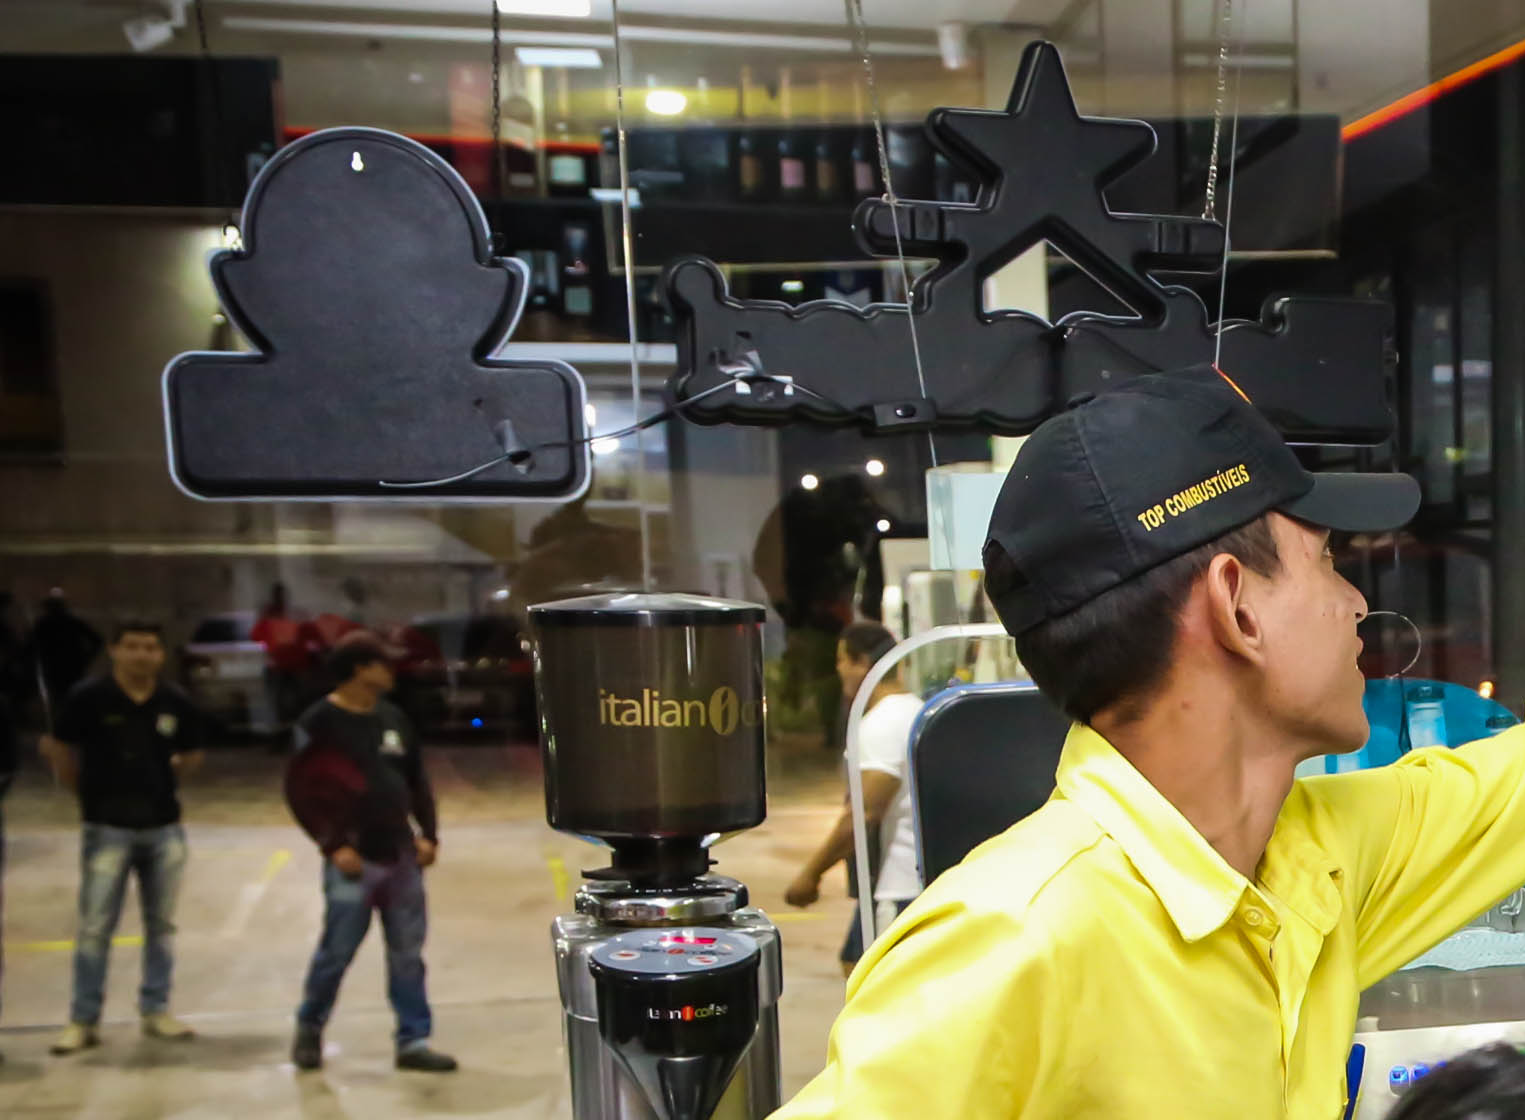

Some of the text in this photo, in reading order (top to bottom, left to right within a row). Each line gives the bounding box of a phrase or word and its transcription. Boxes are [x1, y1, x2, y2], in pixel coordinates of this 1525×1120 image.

[1137, 463, 1250, 532] TOP COMBUSTÍVEIS
[600, 688, 706, 728] italian
